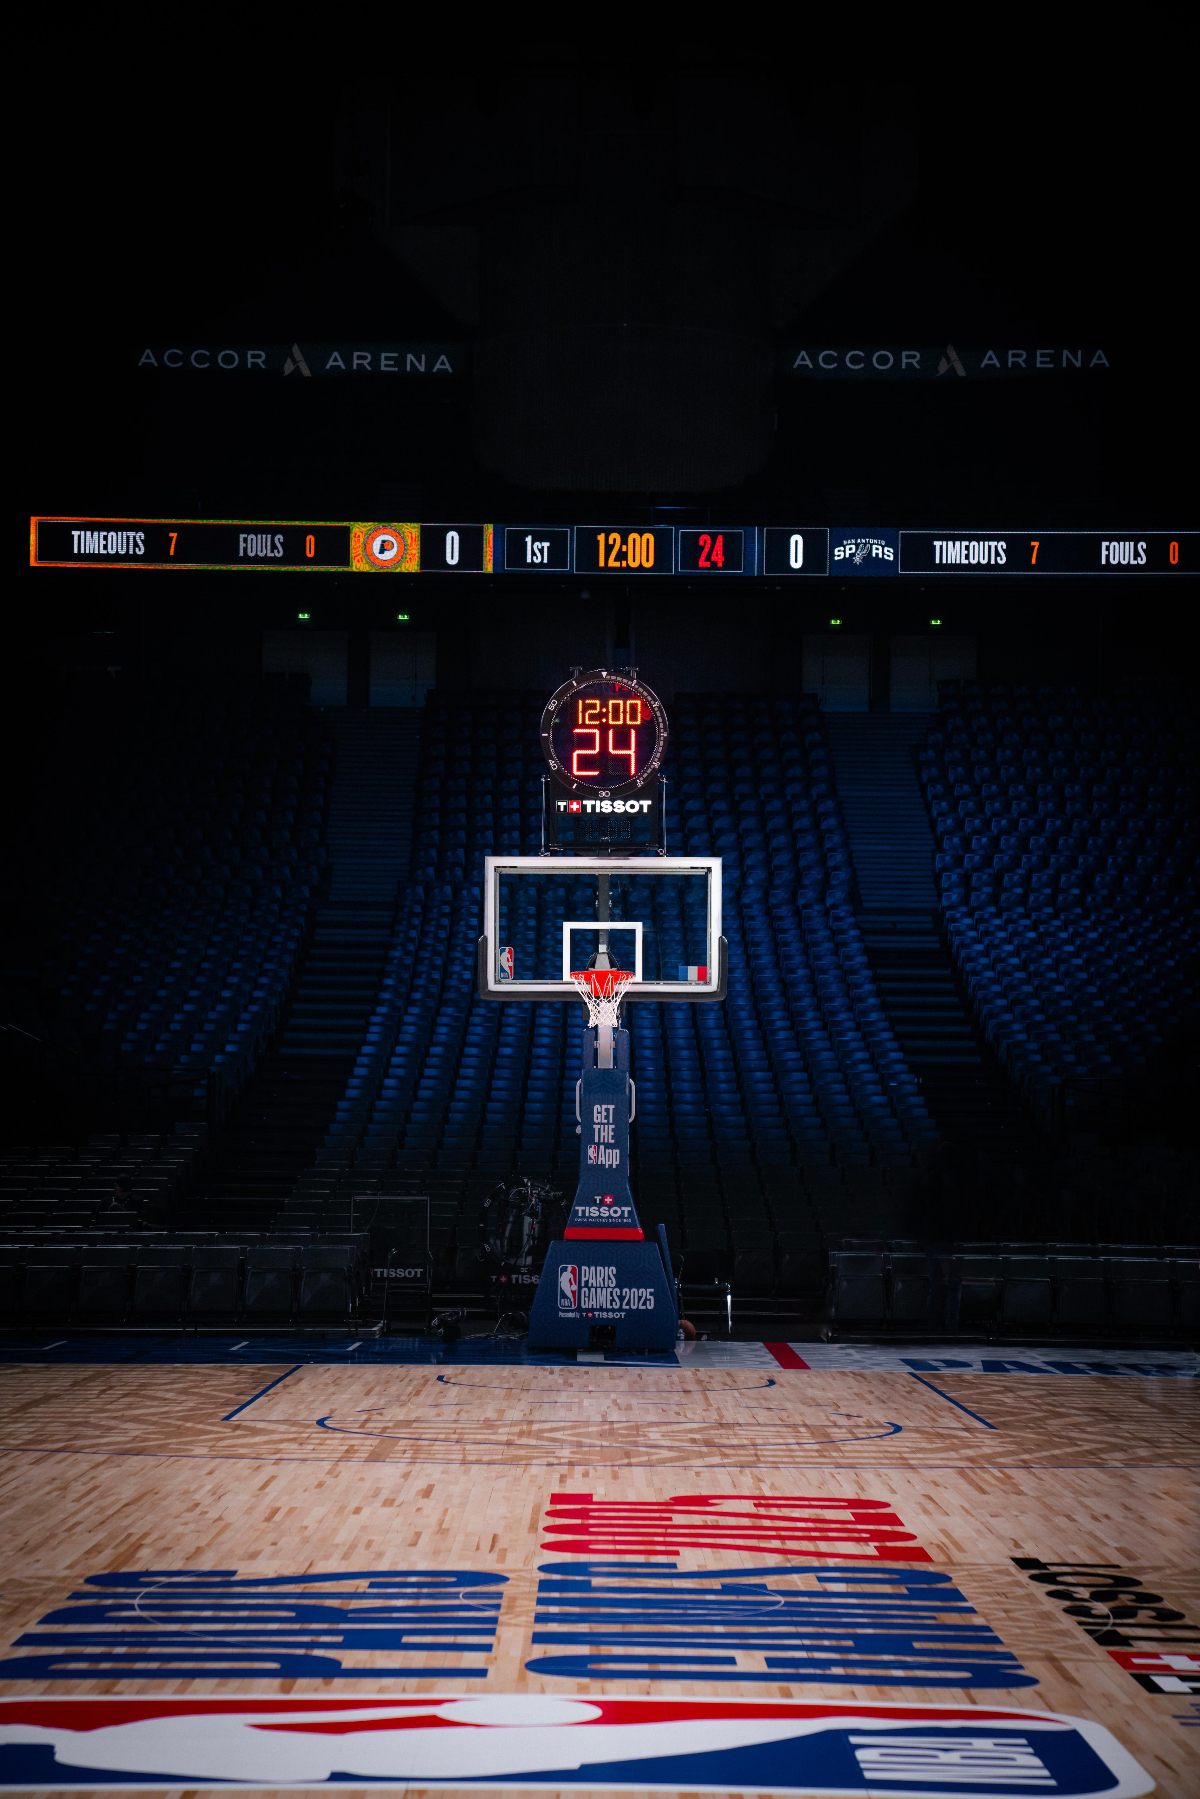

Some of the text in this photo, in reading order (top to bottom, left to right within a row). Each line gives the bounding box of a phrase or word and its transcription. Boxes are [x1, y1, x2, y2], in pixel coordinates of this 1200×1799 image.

[138, 349, 453, 373] ACCOR ARENA
[793, 349, 1110, 370] ACCOR ARENA
[71, 531, 178, 556] TIMEOUTS 7
[239, 534, 315, 558] FOULS 0
[446, 531, 459, 566] 0
[525, 535, 550, 564] 1ST
[597, 533, 654, 568] 12:00
[698, 534, 724, 568] 24
[790, 534, 803, 569] 0
[934, 541, 1040, 565] TIMEOUTS 7
[1101, 541, 1179, 565] FOULS 0
[577, 699, 642, 725] 12:00
[572, 728, 636, 776] 24
[598, 790, 611, 798] 30
[557, 800, 652, 813] T TISSOT
[593, 1104, 616, 1123] GET
[593, 1124, 616, 1144] THE
[597, 1145, 620, 1169] App
[594, 1195, 602, 1204] T
[575, 1206, 632, 1218] TISSOT
[373, 1268, 423, 1278] TISSOT
[511, 1274, 540, 1285] TISS
[581, 1265, 617, 1287] PARIS
[580, 1287, 655, 1309] GAMES 2025
[594, 1311, 626, 1319] TISSOT
[525, 1493, 1040, 1689] GAMES 2025
[0, 1570, 510, 1679] PARIS
[848, 1735, 1058, 1787] NBA
